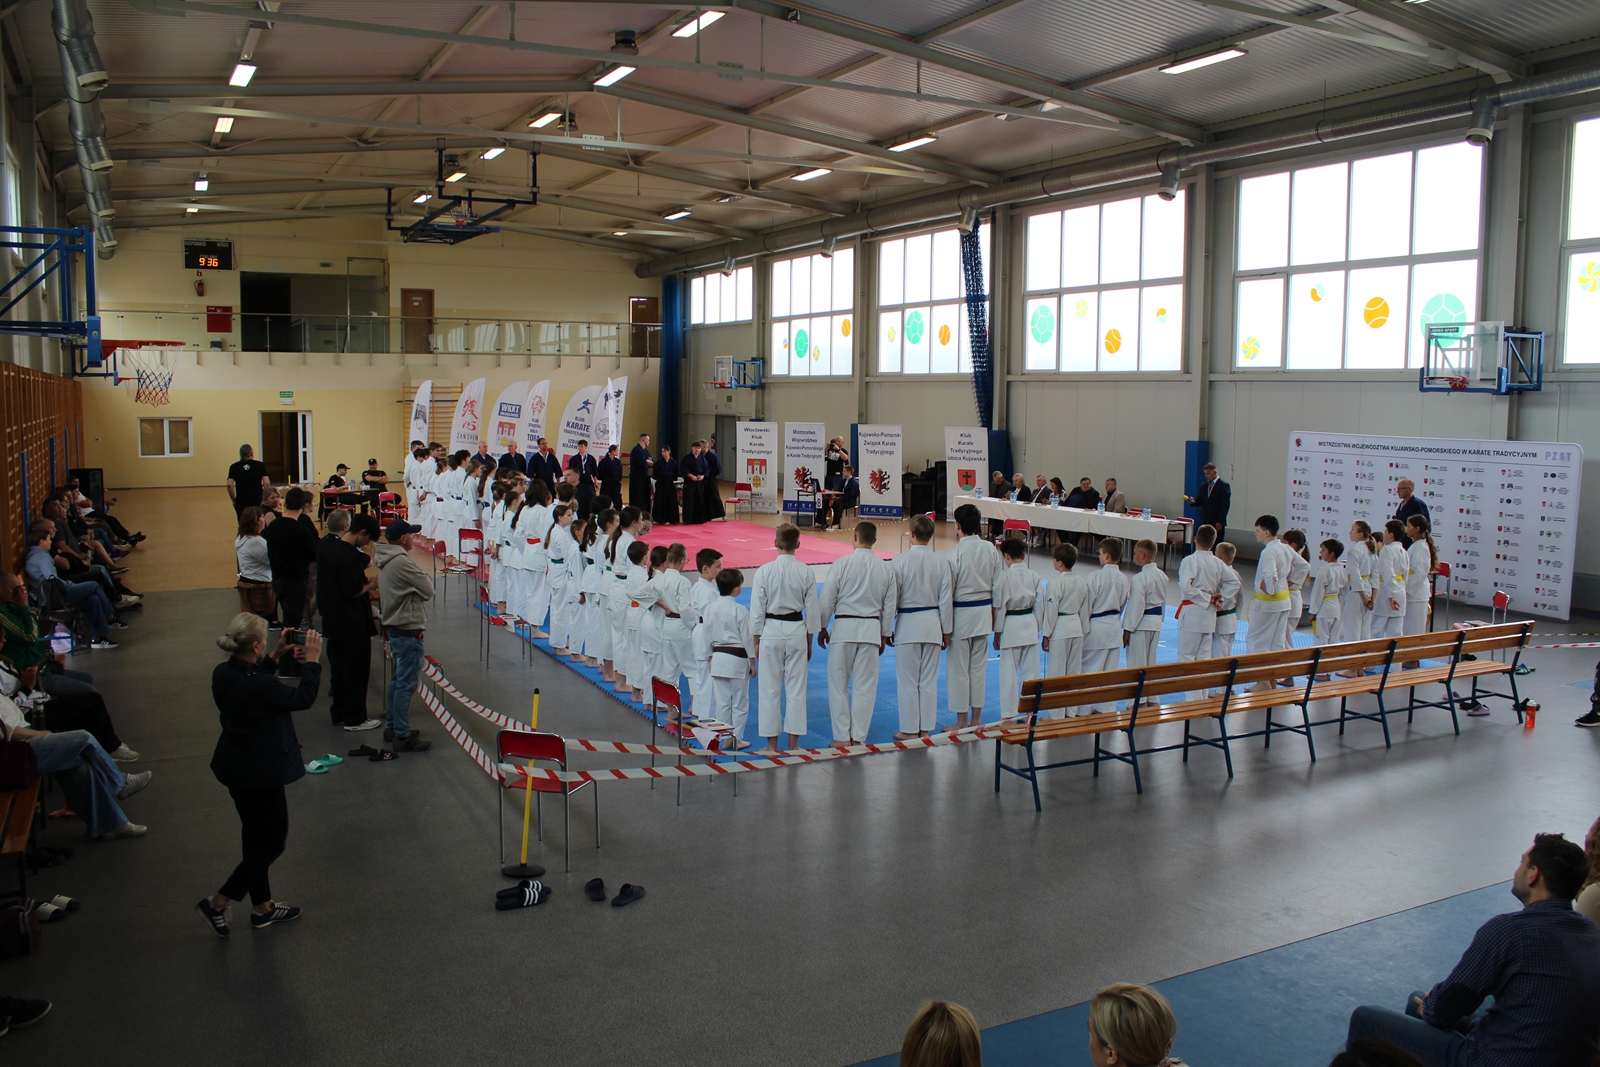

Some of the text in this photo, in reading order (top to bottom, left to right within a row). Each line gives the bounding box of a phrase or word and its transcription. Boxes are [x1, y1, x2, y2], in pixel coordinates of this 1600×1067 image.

[566, 421, 590, 432] KARATE
[1391, 446, 1461, 454] KUJAWSKO-POMORSKIEGO
[1545, 451, 1572, 461] PZKT
